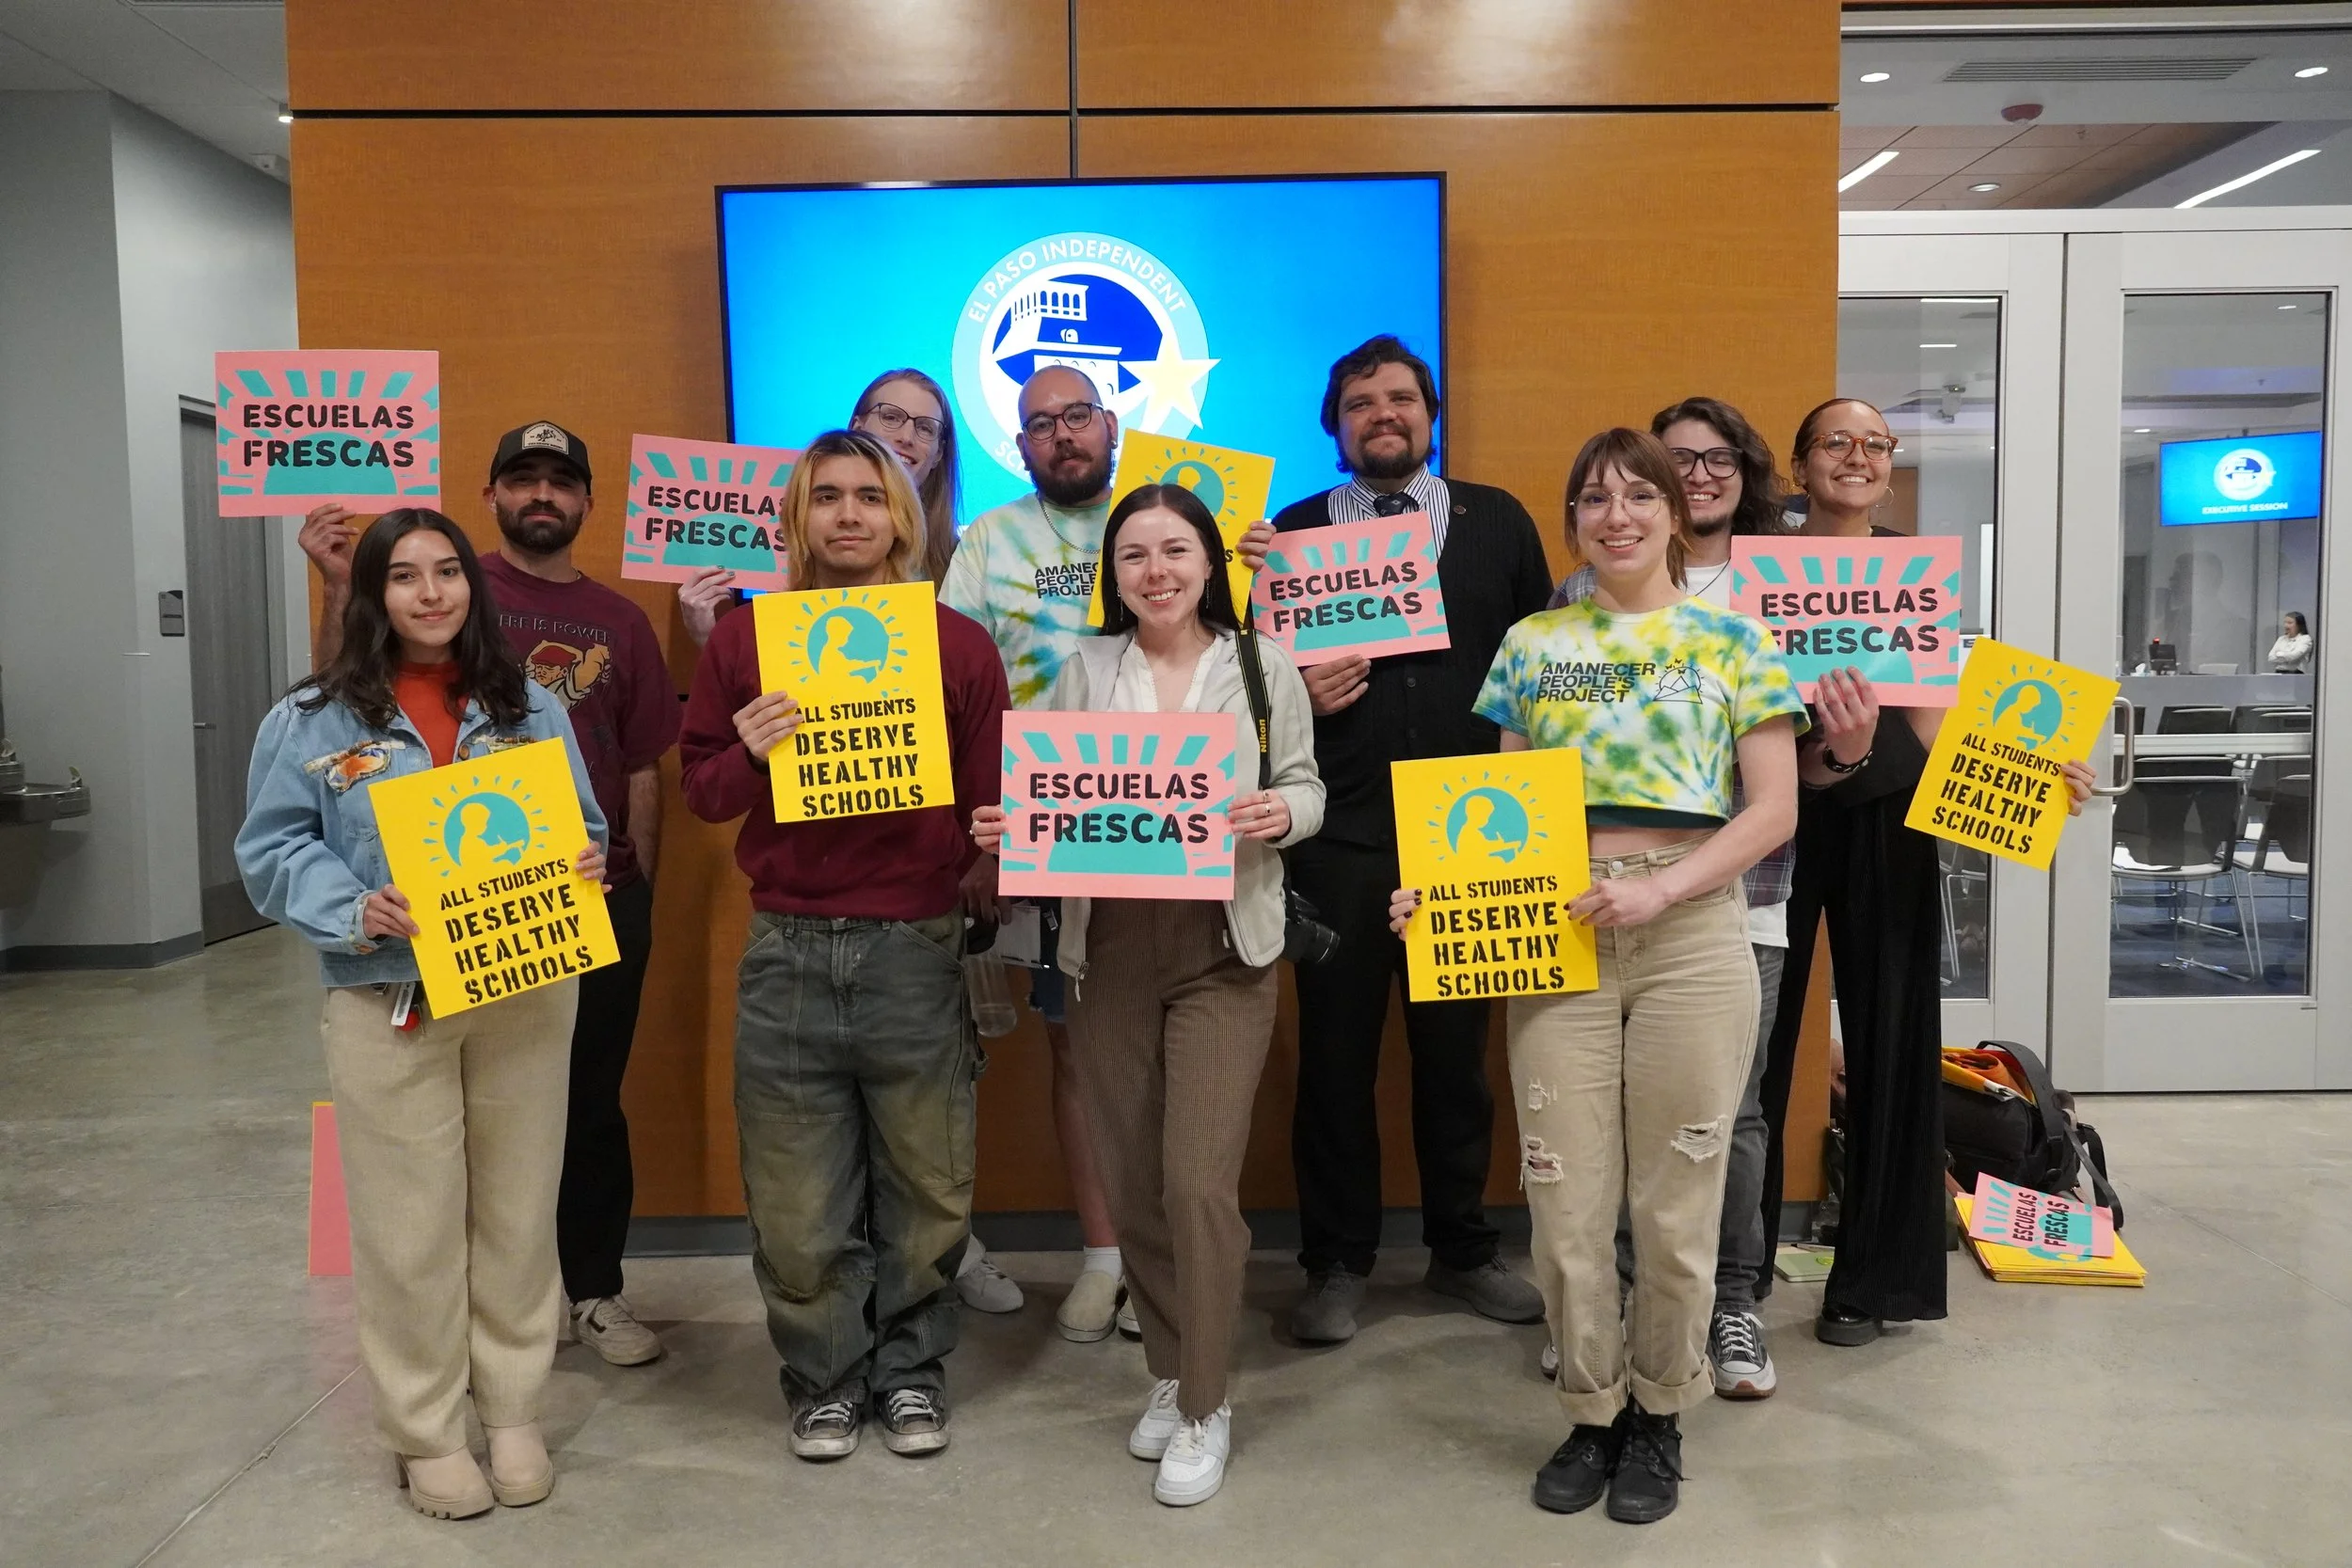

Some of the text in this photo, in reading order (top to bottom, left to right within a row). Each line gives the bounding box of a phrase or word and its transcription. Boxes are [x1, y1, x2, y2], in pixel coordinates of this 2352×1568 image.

[967, 238, 1186, 324] EL PASO INDEPENDENT
[245, 404, 413, 429] ESCUELAS
[245, 440, 413, 467] FRESCAS
[647, 485, 784, 516] ESCUELA
[2201, 500, 2289, 515] EXECUTIVE SESSION
[646, 518, 786, 551] FRESCAS
[1035, 562, 1099, 579] AMANEC
[1036, 573, 1097, 589] PEOPLE
[1270, 562, 1417, 601] ESCUELAS
[1037, 584, 1095, 599] PROJE
[1762, 589, 1937, 617] ESCUELAS
[500, 613, 529, 629] ERE
[1274, 593, 1422, 632] FRESCAS
[1538, 675, 1635, 689] PEOPLE'S
[1541, 662, 1656, 676] AMANECER
[831, 699, 915, 720] STUDENTS
[1536, 689, 1629, 704] PROJECT
[796, 723, 915, 755] DESERVE
[1259, 719, 1267, 753] Nikon
[800, 754, 917, 786] HEALTHY
[1963, 734, 2058, 776] ALL STUDENTS
[1030, 774, 1208, 799] ESCUELAS
[1951, 753, 2051, 802] DESERVE
[803, 784, 925, 817] SCHOOLS
[1941, 780, 2042, 827] HEALTHY
[1030, 814, 1208, 843] FRESCAS
[1932, 806, 2031, 853] SCHOOLS
[441, 860, 567, 910] ALL STUDENTS
[1430, 877, 1557, 901] ALL STUDENTS
[446, 884, 575, 942] DESERVE
[1431, 902, 1557, 934] DESERVE
[455, 915, 579, 974] HEALTHY
[1435, 934, 1558, 965] HEALTHY
[466, 946, 592, 1003] SCHOOLS
[1438, 967, 1564, 996] SCHOOLS
[2013, 1193, 2037, 1241] ESCUELAS
[2045, 1201, 2069, 1245] FRESCAS
